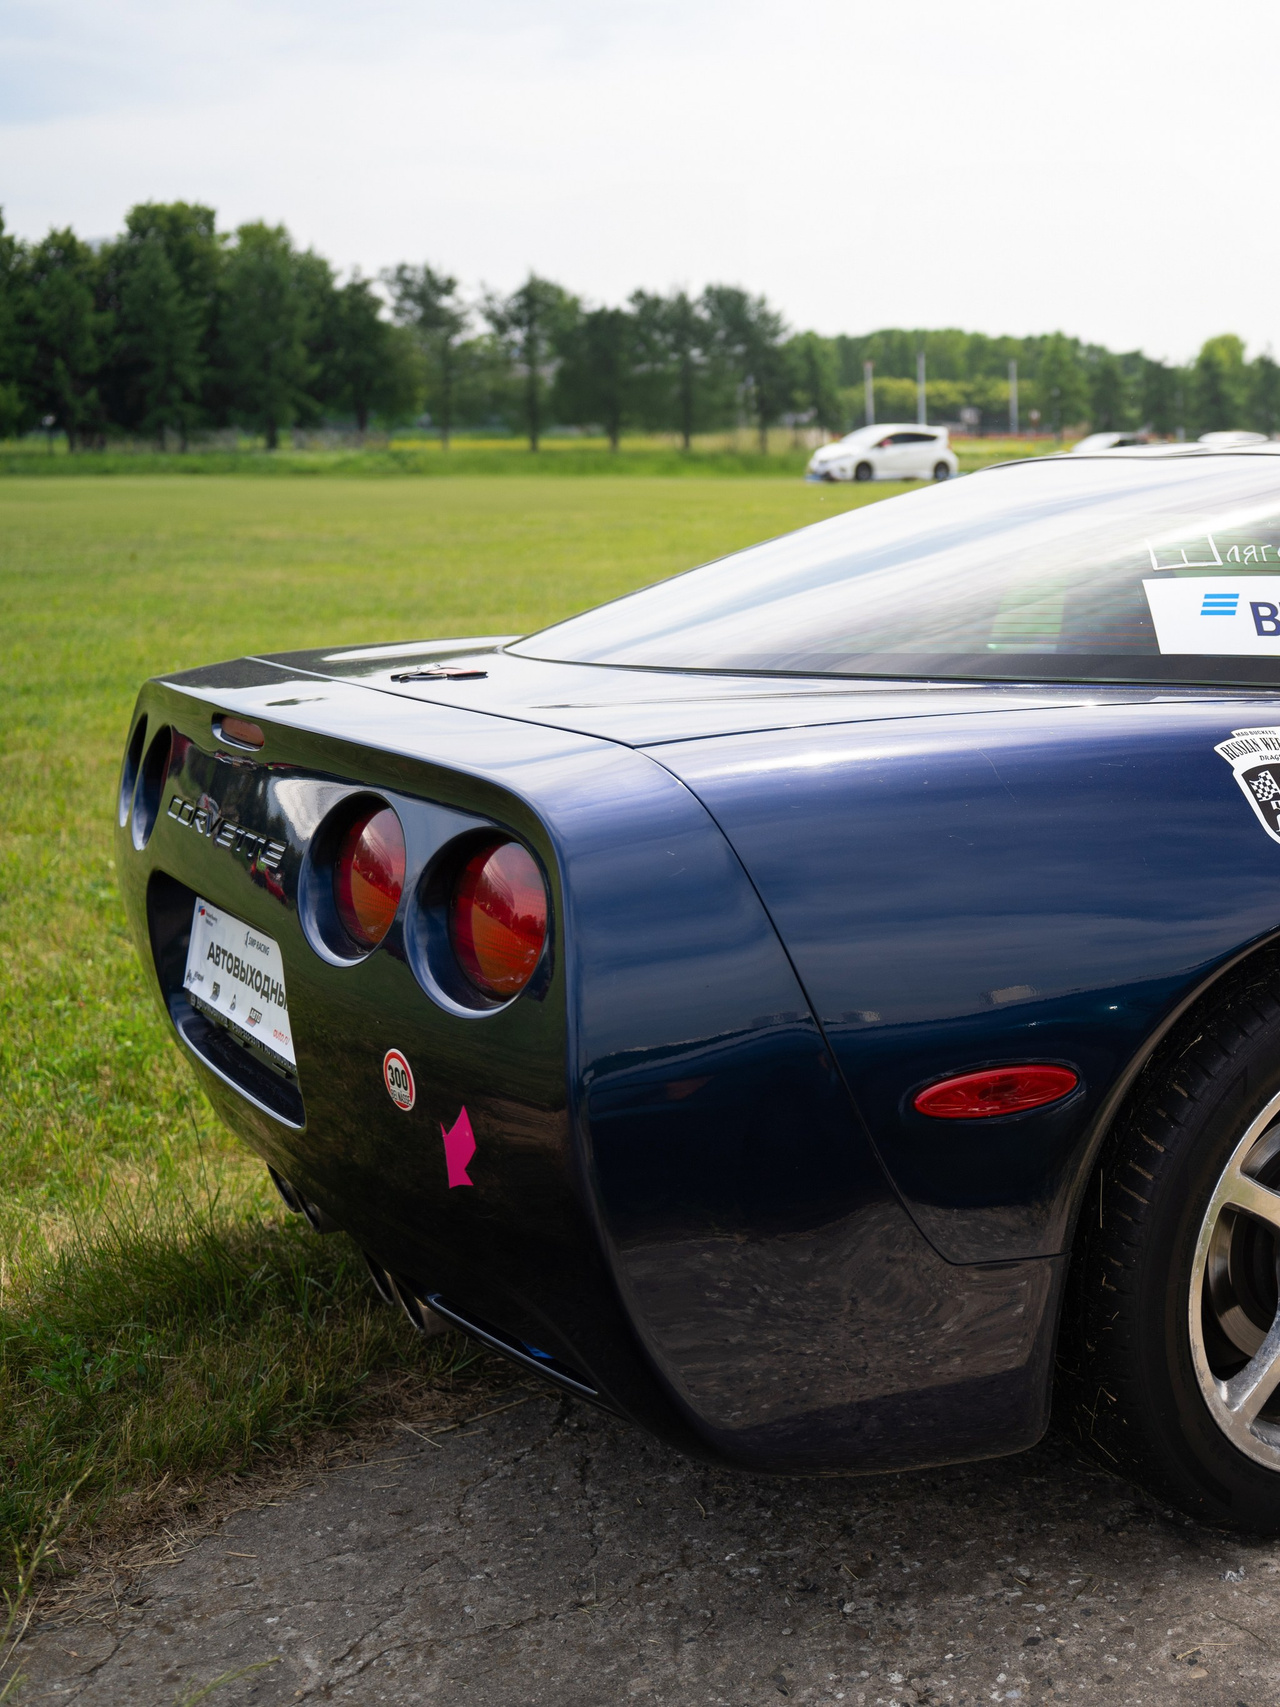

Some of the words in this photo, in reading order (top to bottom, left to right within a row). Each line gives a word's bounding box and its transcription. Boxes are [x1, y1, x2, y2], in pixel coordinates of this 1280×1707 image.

[1220, 737, 1262, 761] RUSSIAN
[167, 794, 287, 869] CORVETTE
[256, 940, 270, 956] RACING
[388, 1064, 408, 1091] 300
